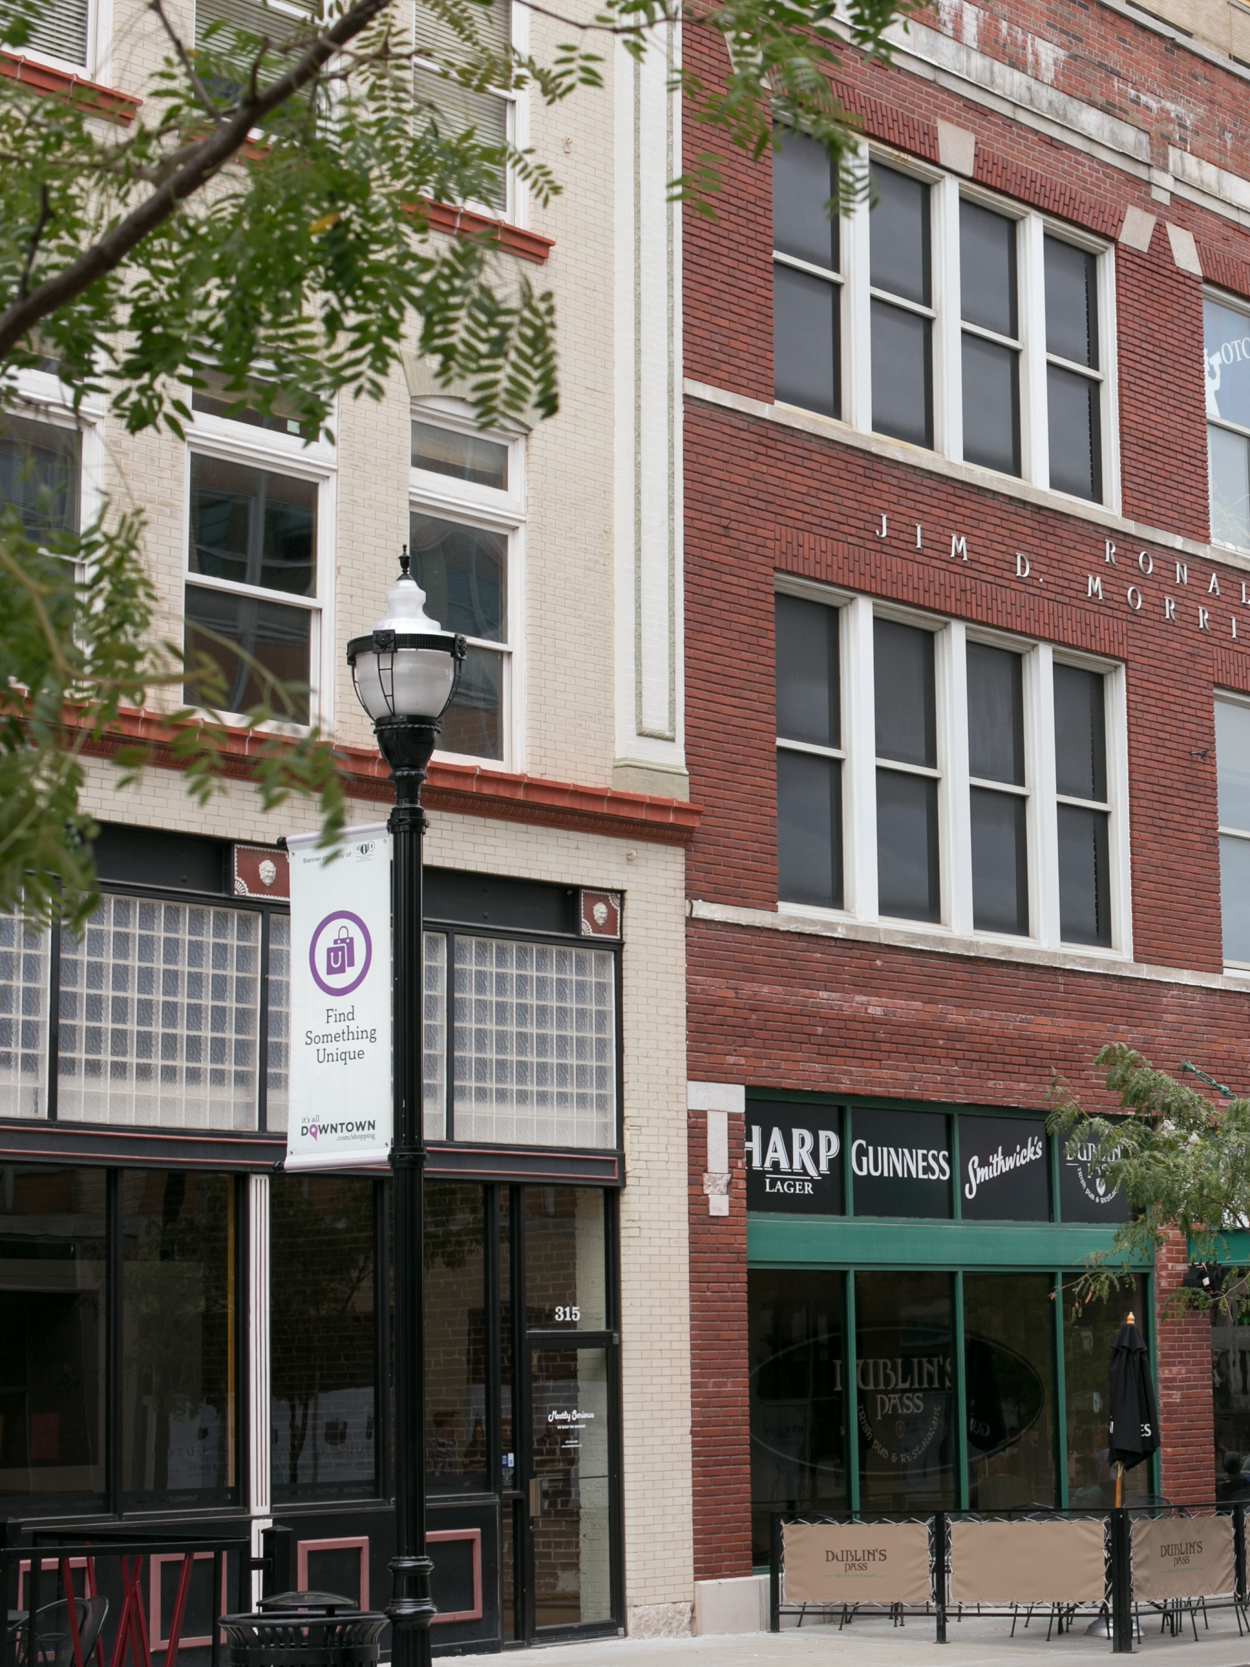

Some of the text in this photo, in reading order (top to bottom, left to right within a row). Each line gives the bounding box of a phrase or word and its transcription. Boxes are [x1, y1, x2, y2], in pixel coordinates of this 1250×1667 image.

[875, 513, 968, 562] JIM
[1016, 552, 1044, 582] D.
[326, 1004, 355, 1024] Find
[305, 1024, 377, 1046] Something
[316, 1047, 365, 1066] Unique
[311, 1114, 320, 1123] all
[301, 1119, 376, 1141] DOWNTOWN
[745, 1125, 840, 1179] HARP
[851, 1138, 951, 1181] GUINNESS
[964, 1135, 1043, 1200] Smithwick's
[765, 1178, 814, 1195] LAGER
[554, 1306, 581, 1322] 315
[876, 1392, 924, 1420] PASS
[825, 1548, 888, 1563] DUBLIN'S
[1160, 1540, 1203, 1558] DUBLIN'S
[844, 1562, 868, 1573] PASS
[1173, 1555, 1190, 1568] PASS
